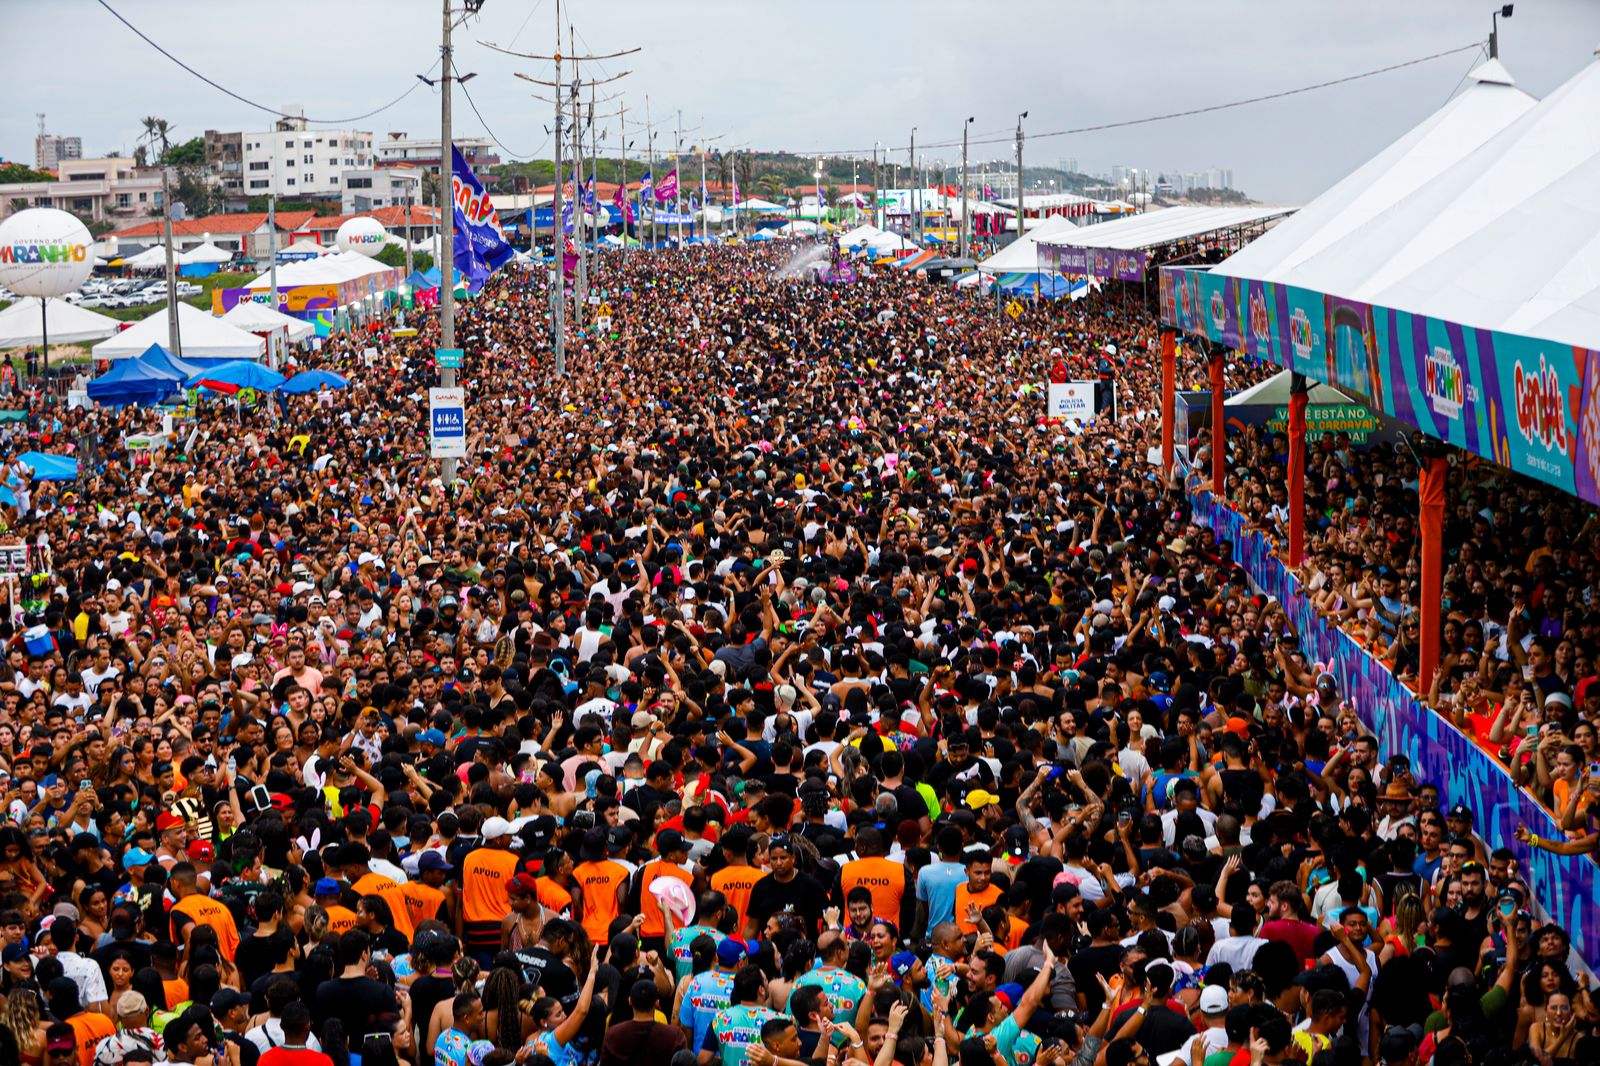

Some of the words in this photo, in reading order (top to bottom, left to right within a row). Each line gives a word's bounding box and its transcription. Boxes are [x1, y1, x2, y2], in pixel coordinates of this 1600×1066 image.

[1314, 407, 1345, 419] ESTÁ
[1348, 408, 1366, 418] NO
[473, 867, 500, 880] APOIO
[375, 881, 397, 892] APOIO
[585, 876, 610, 885] APOIO
[723, 881, 752, 891] APOIO
[856, 877, 890, 886] APOIO
[404, 895, 424, 908] POIO
[199, 907, 221, 917] APOIO
[515, 952, 548, 968] AIDERS
[690, 997, 732, 1010] MARANH
[719, 1031, 762, 1044] MARANH
